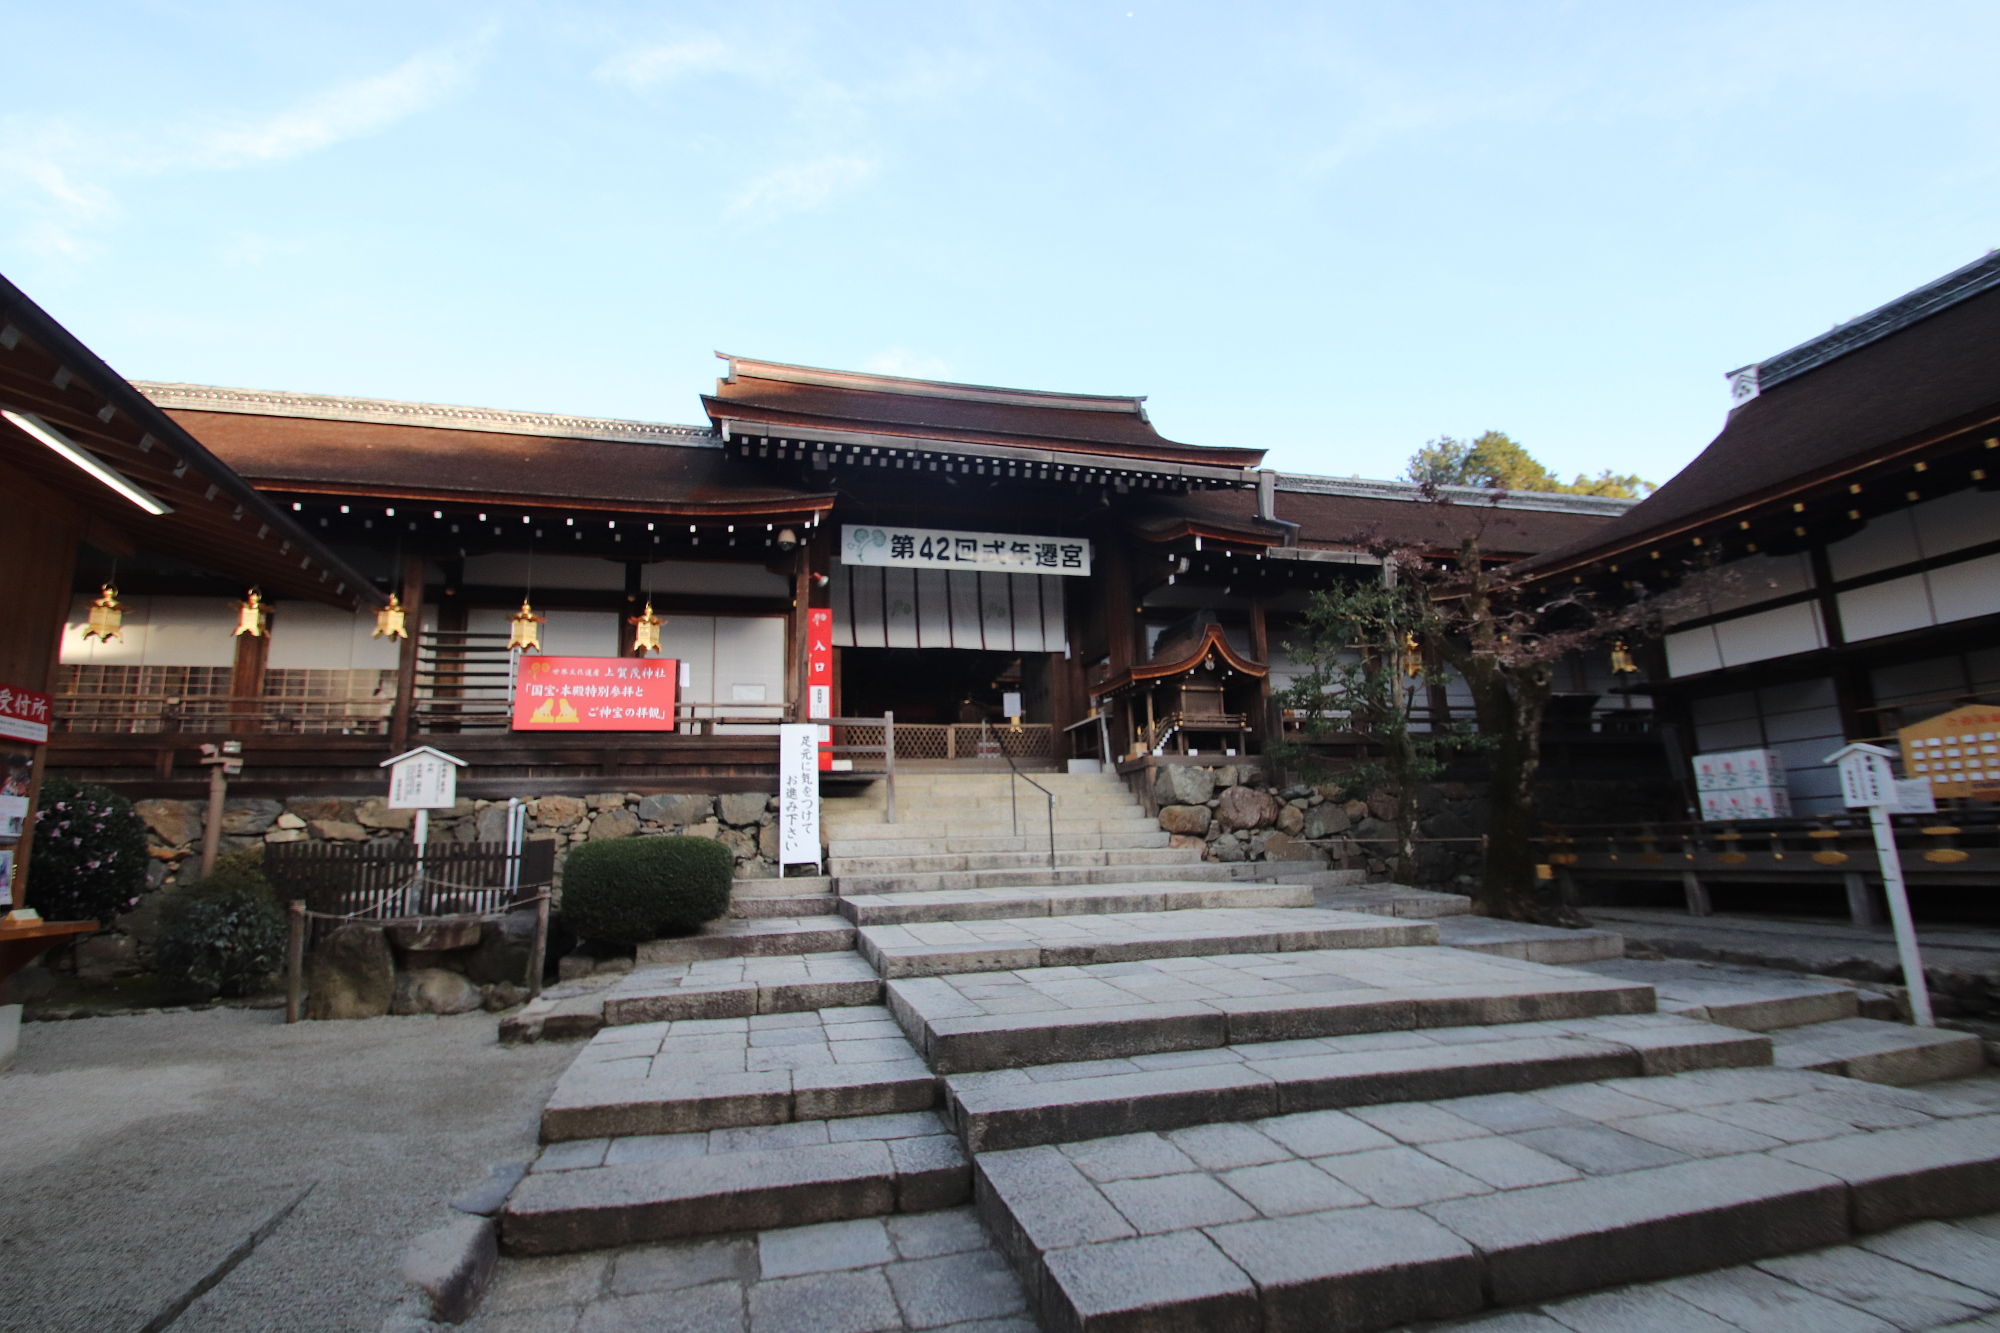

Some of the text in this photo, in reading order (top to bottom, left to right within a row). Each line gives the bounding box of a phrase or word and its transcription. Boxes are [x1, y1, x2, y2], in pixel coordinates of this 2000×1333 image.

[814, 640, 826, 673] 入口
[604, 667, 666, 680] 上賀茂神社
[588, 705, 666, 720] ご神宝の拝観」
[801, 735, 813, 834] 足元に気をつけて
[785, 775, 798, 851] お進み下さい
